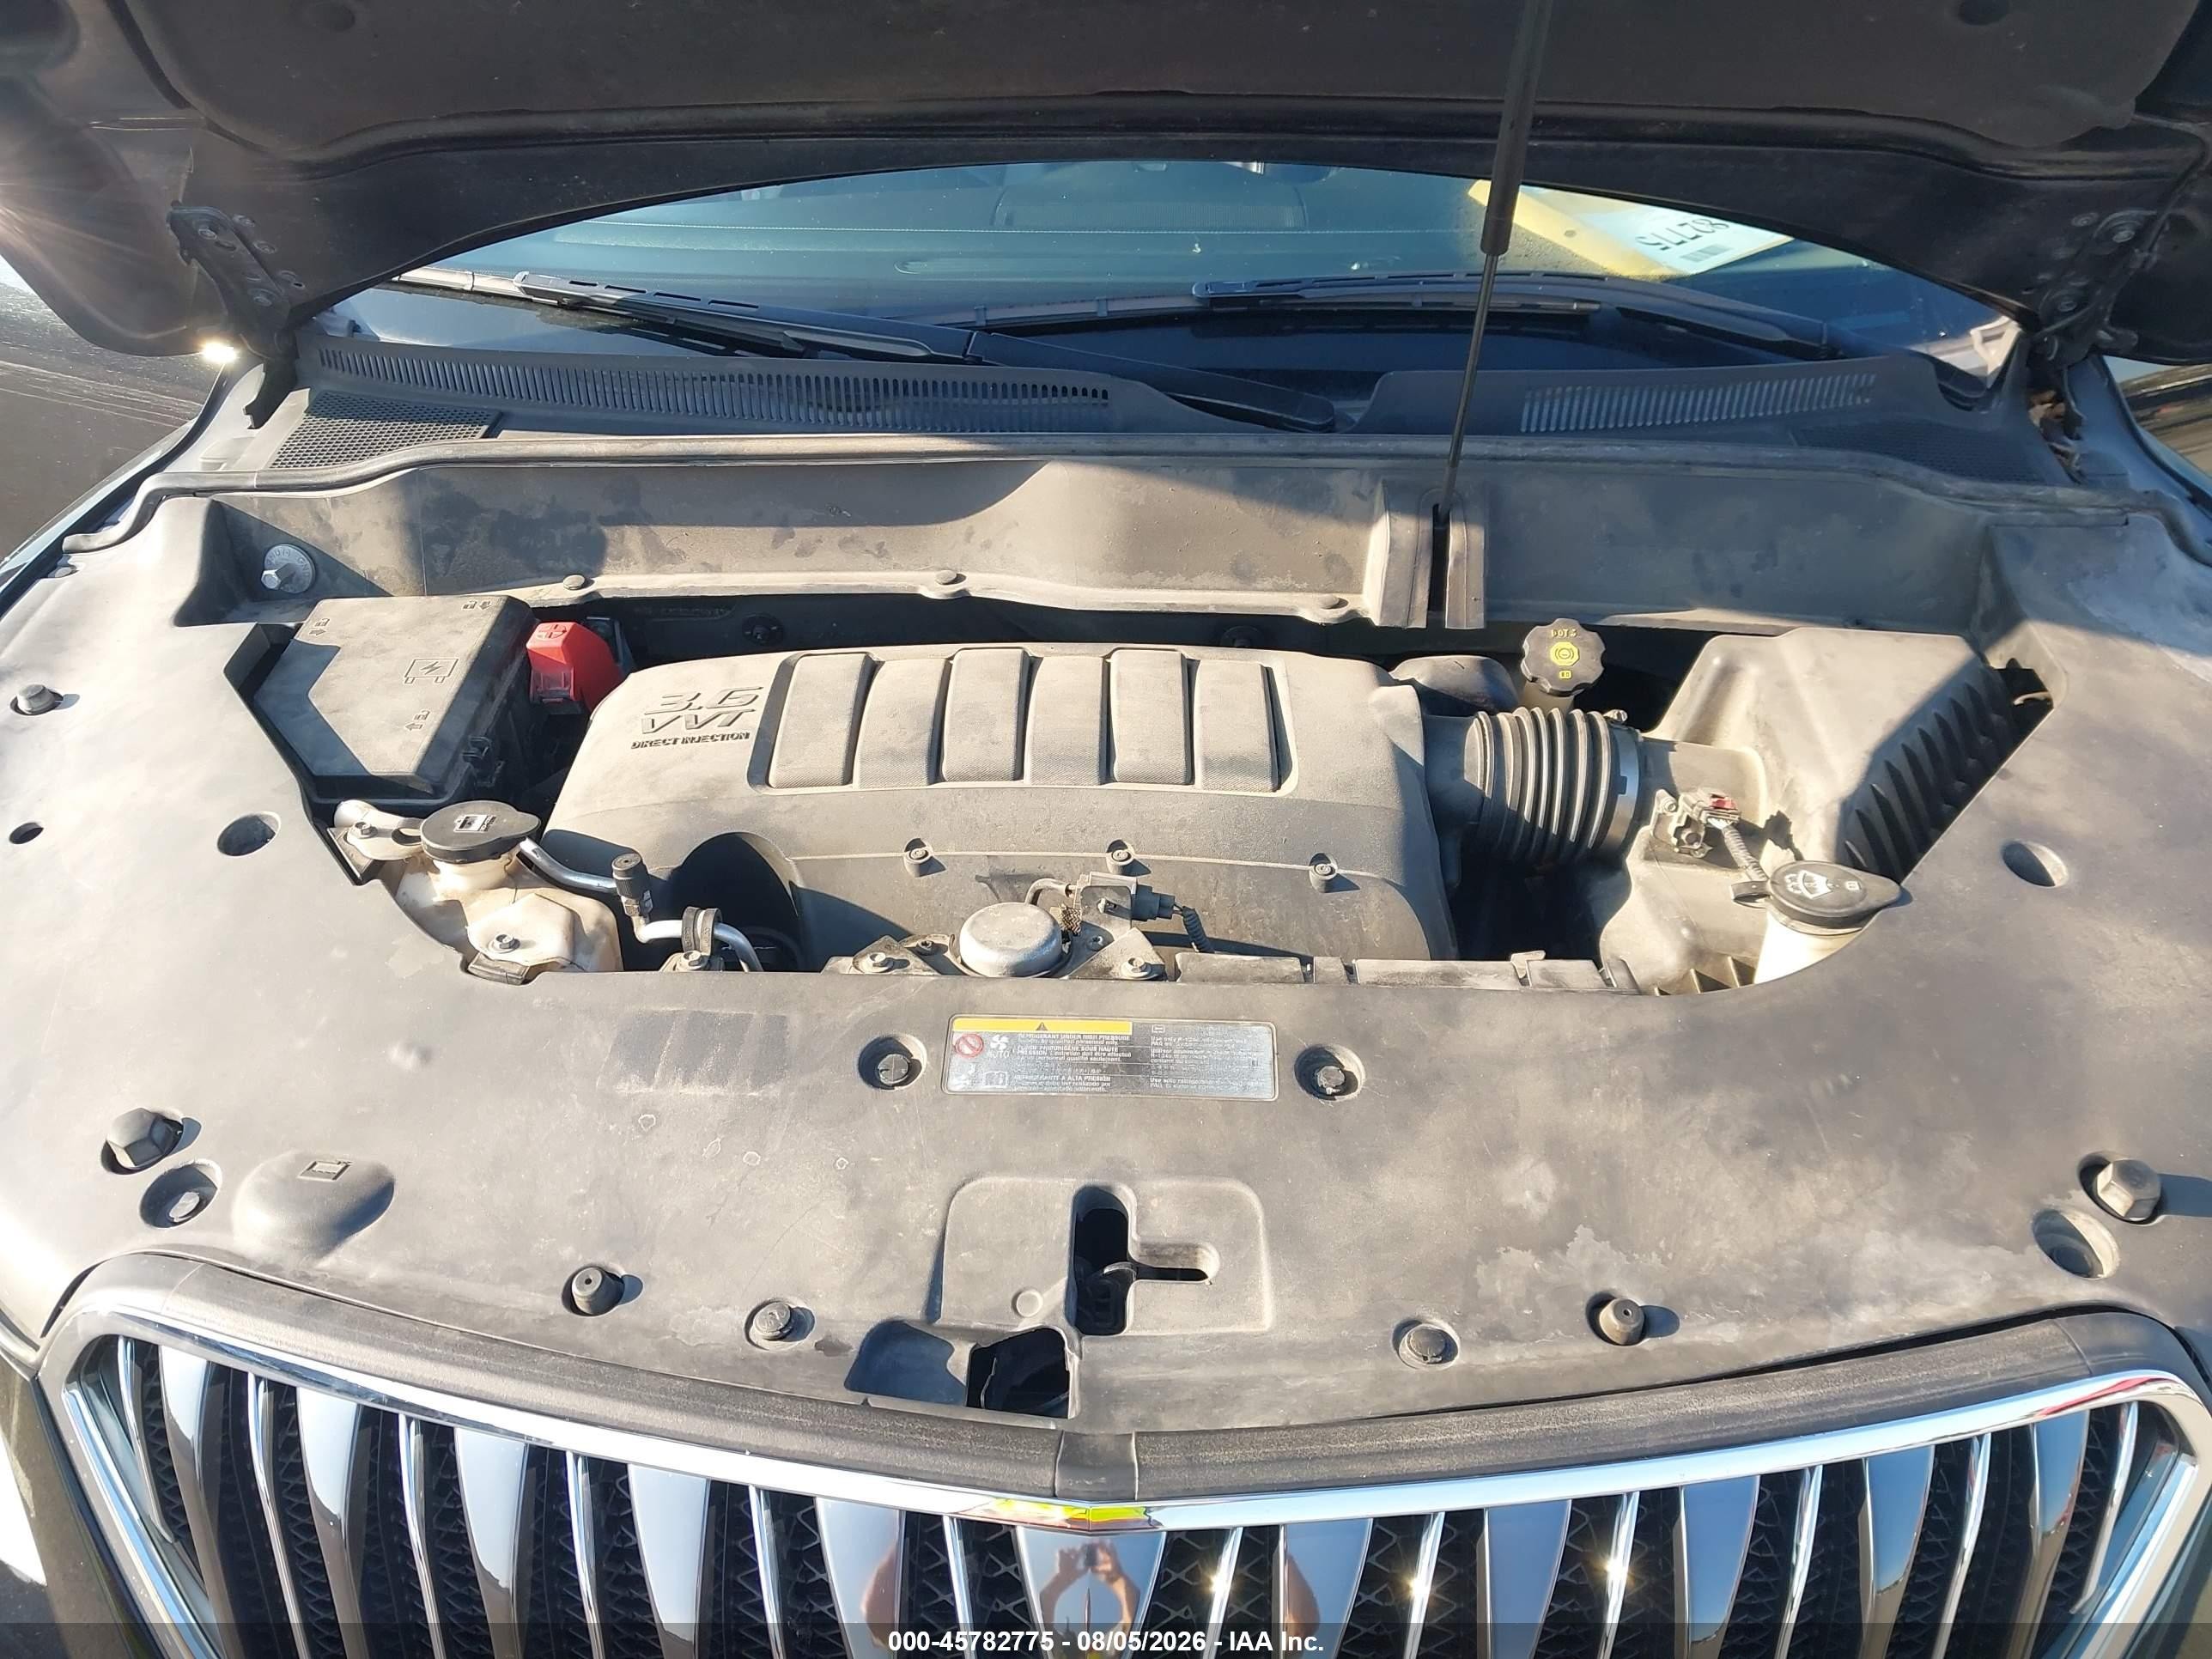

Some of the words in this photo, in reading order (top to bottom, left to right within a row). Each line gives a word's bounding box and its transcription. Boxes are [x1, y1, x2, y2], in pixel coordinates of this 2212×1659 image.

[1634, 218, 1729, 251] 82775
[1551, 628, 1570, 638] DOT
[644, 686, 763, 715] 3.6
[641, 709, 756, 734] VVT
[630, 736, 682, 750] DIRECT
[681, 732, 750, 745] INJECTION
